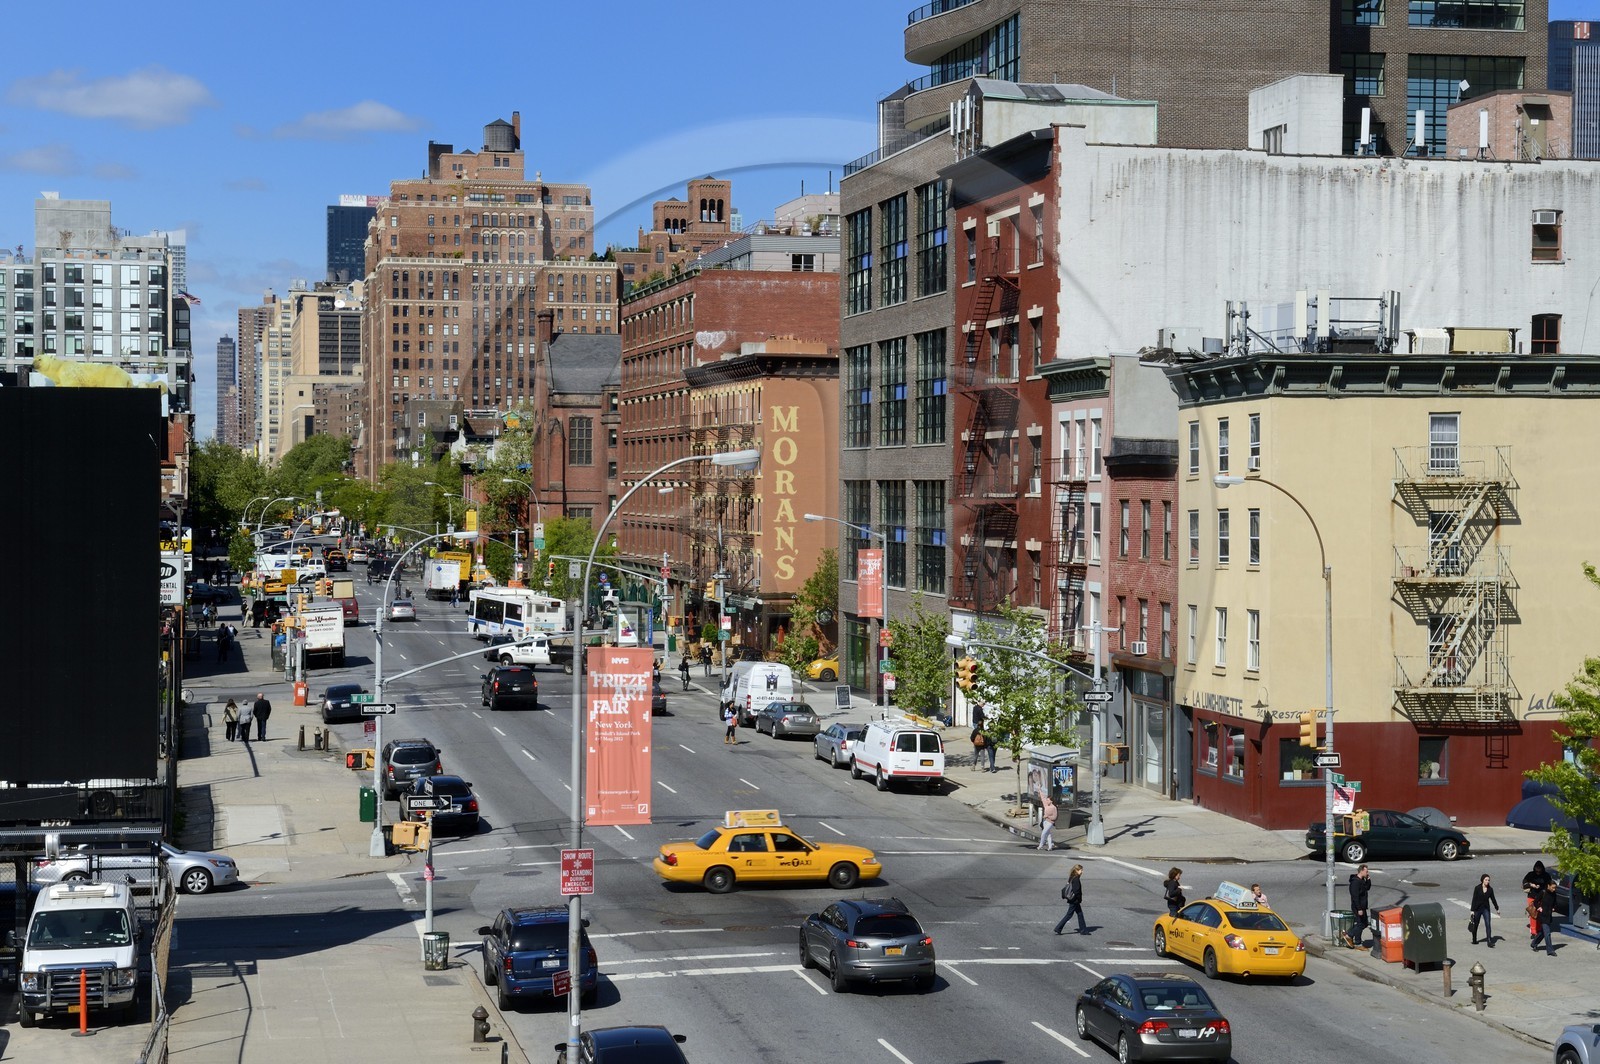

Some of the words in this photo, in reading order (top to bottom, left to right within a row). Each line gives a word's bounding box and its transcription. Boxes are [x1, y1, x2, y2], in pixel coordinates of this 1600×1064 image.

[770, 405, 800, 580] MORAN'S
[592, 672, 648, 688] FRIEZE
[612, 685, 647, 701] ART
[592, 699, 629, 715] FAIR
[1192, 690, 1201, 708] LA
[1201, 691, 1244, 717] LUNCHONETTE
[1527, 693, 1544, 711] La
[595, 721, 612, 729] New
[614, 721, 633, 729] York
[563, 852, 577, 860] SNOW
[578, 852, 592, 860] ROUTE
[562, 869, 569, 877] NO
[571, 869, 593, 877] STANDING
